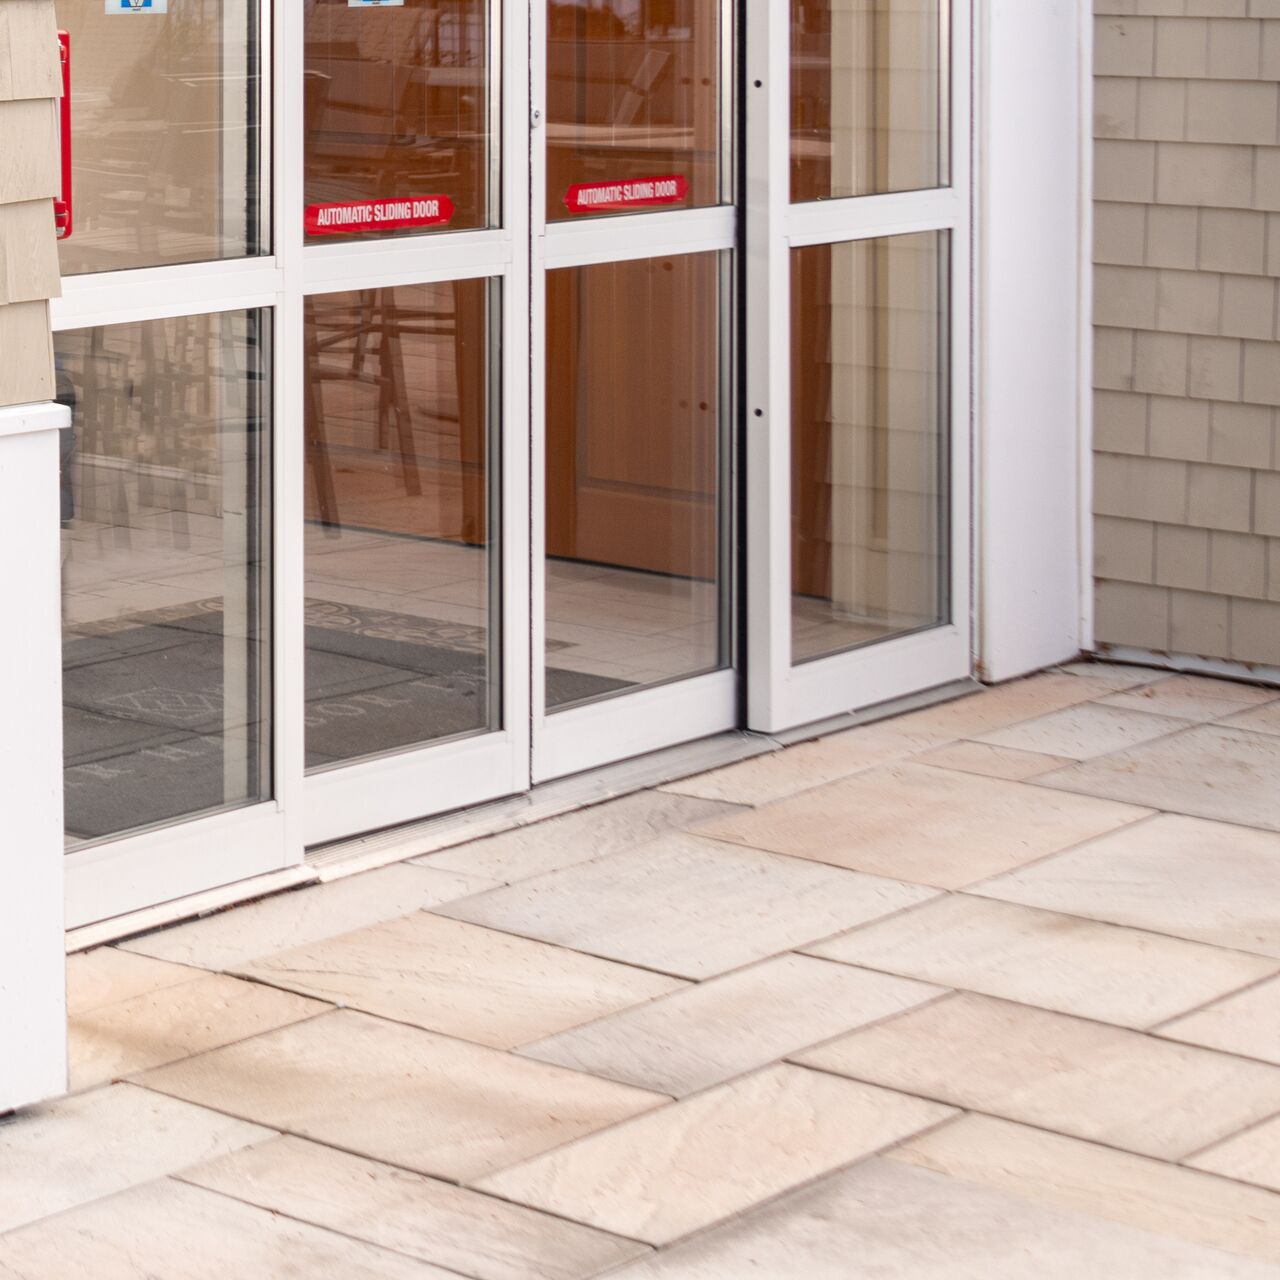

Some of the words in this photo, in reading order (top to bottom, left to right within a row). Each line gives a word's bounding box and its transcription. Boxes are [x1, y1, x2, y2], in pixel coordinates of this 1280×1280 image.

[577, 184, 622, 206] AUTOMATIC
[623, 181, 653, 201] SLIDING
[655, 179, 677, 197] DOOR
[316, 204, 373, 226] AUTOMATIC
[373, 201, 411, 222] SLIDING
[412, 199, 439, 218] DOOR
